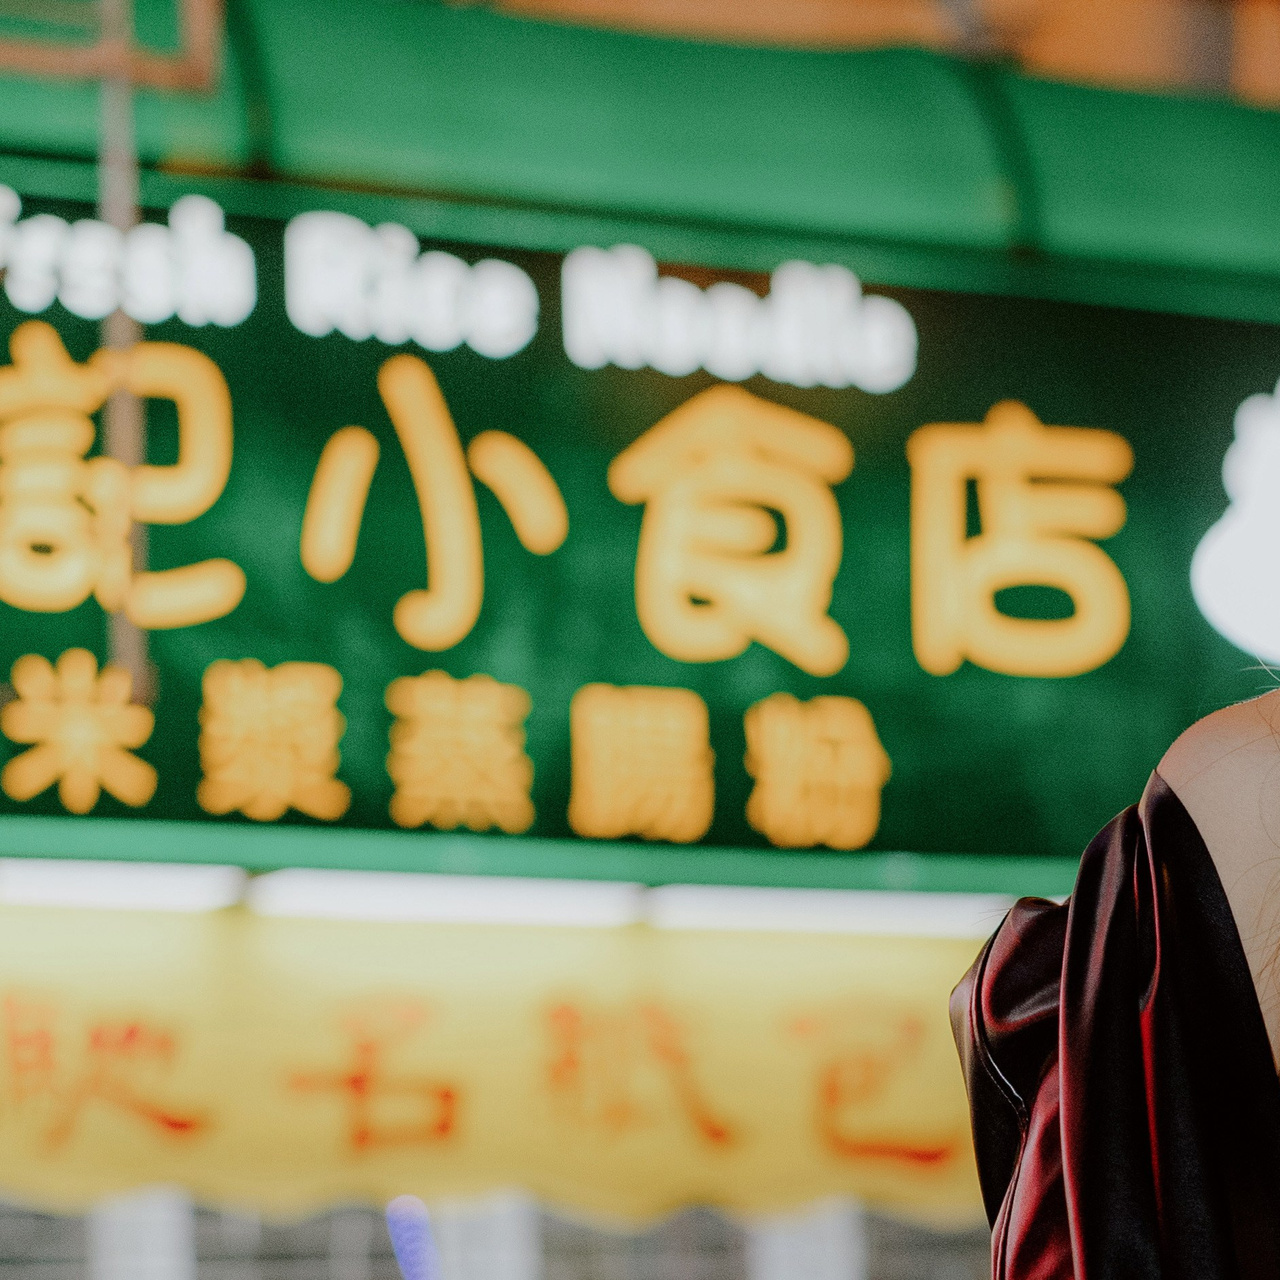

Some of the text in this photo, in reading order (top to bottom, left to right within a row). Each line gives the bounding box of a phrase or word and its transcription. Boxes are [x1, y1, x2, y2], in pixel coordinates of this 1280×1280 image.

[0, 185, 257, 328] resh
[0, 321, 1134, 678] 記小食店
